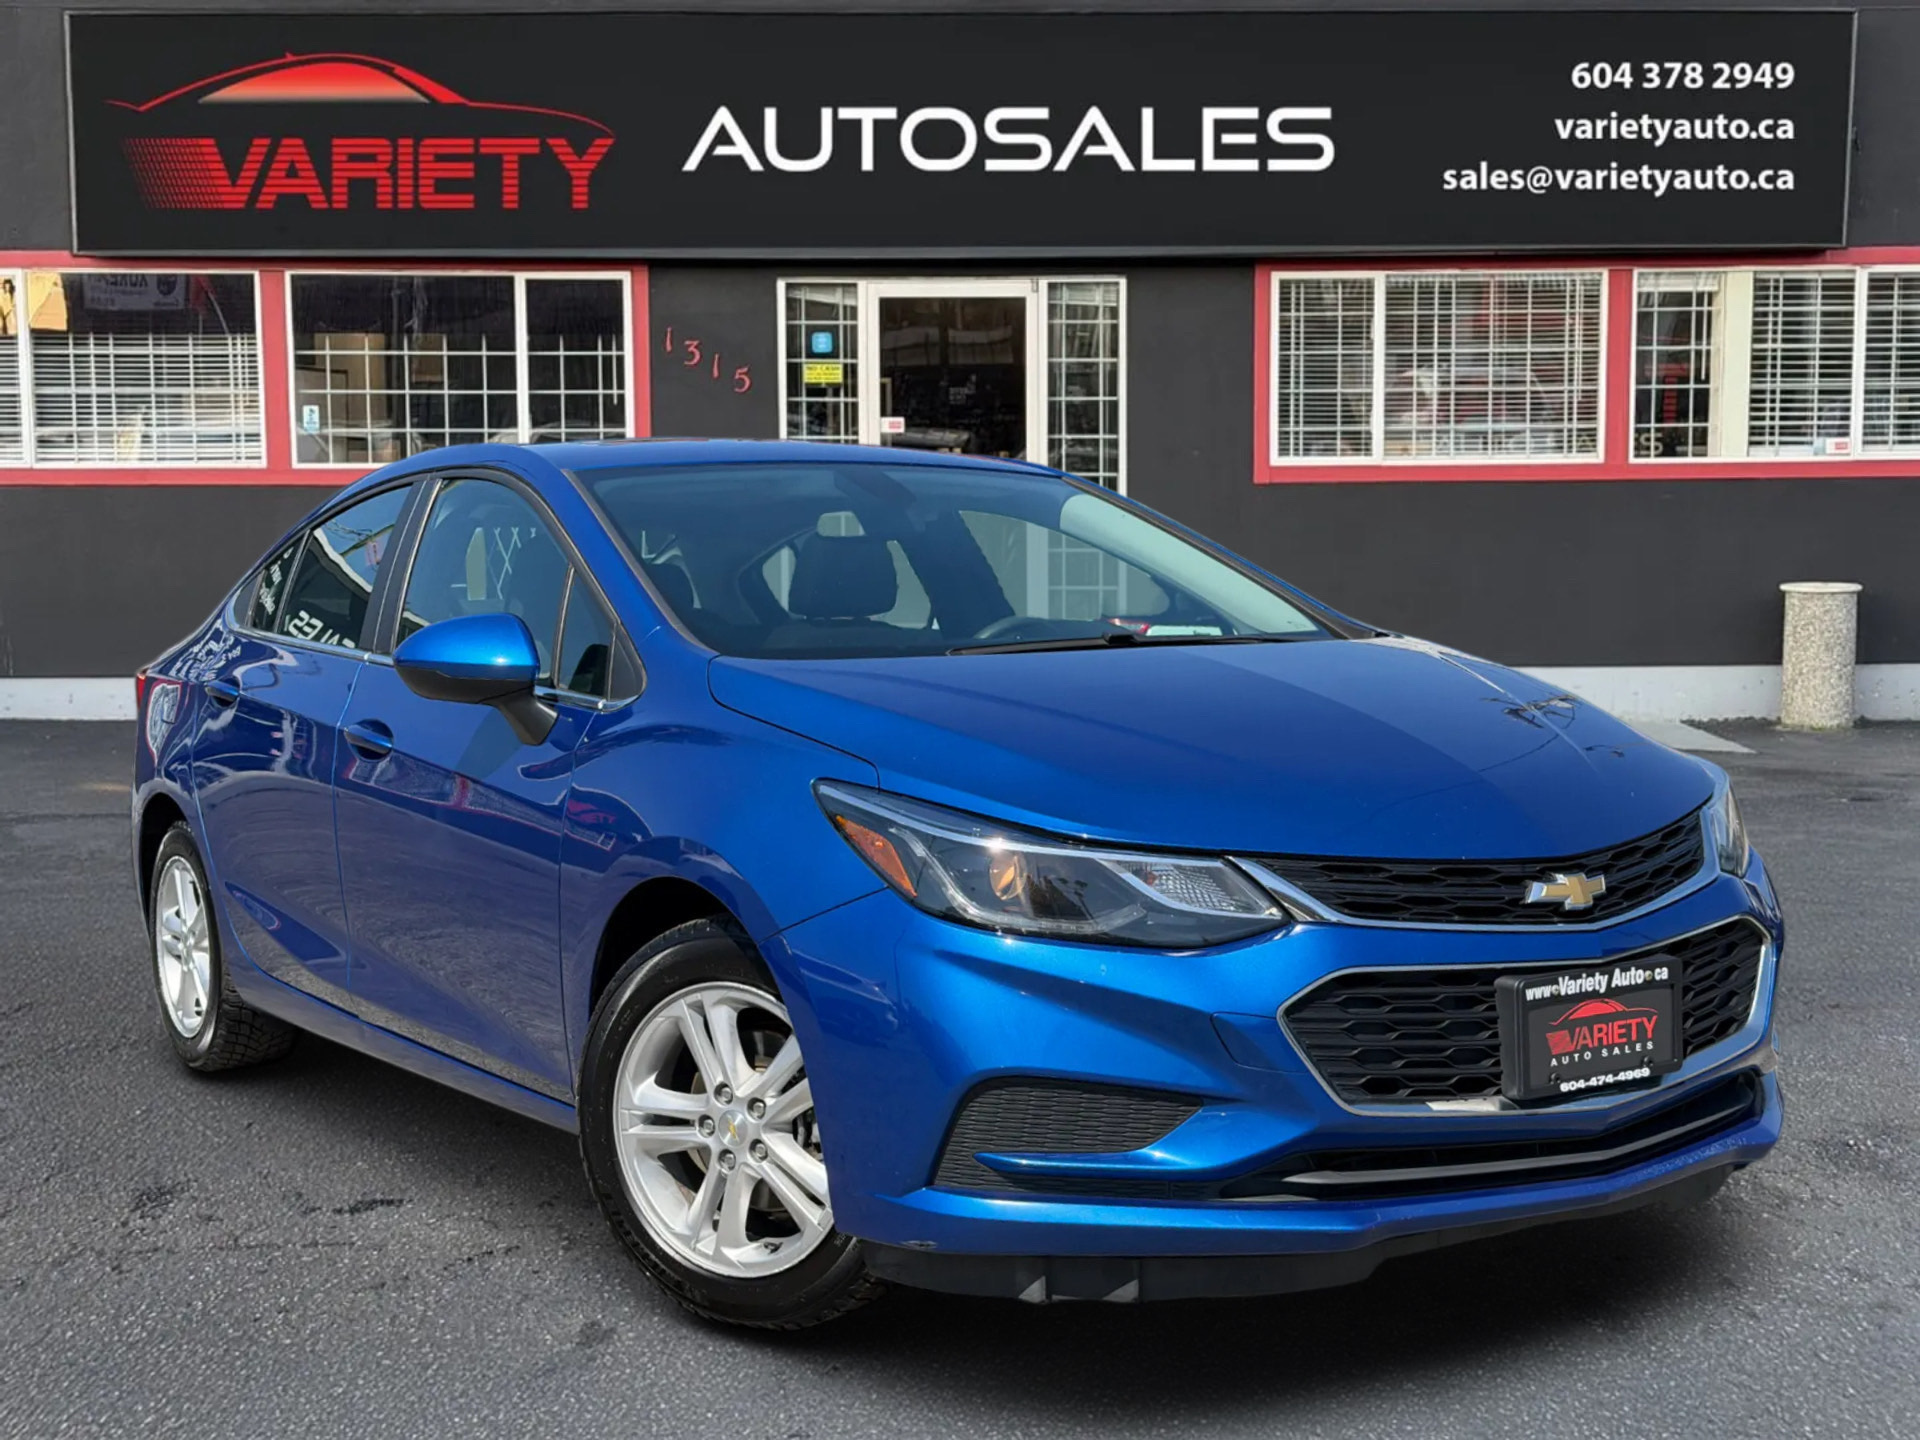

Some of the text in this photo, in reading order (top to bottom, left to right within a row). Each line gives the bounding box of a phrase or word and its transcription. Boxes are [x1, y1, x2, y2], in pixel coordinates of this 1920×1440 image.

[1570, 62, 1795, 89] 604 378 2949
[681, 105, 1335, 172] AUTOSALES
[1554, 111, 1795, 147] varietyauto.ca
[123, 137, 616, 210] VARIETY
[1443, 161, 1795, 198] sales@varietyauto.ca
[1545, 1015, 1658, 1055] VARIETY
[1550, 1041, 1654, 1067] AUTO SALES
[1559, 1067, 1651, 1092] 604-474-4969
